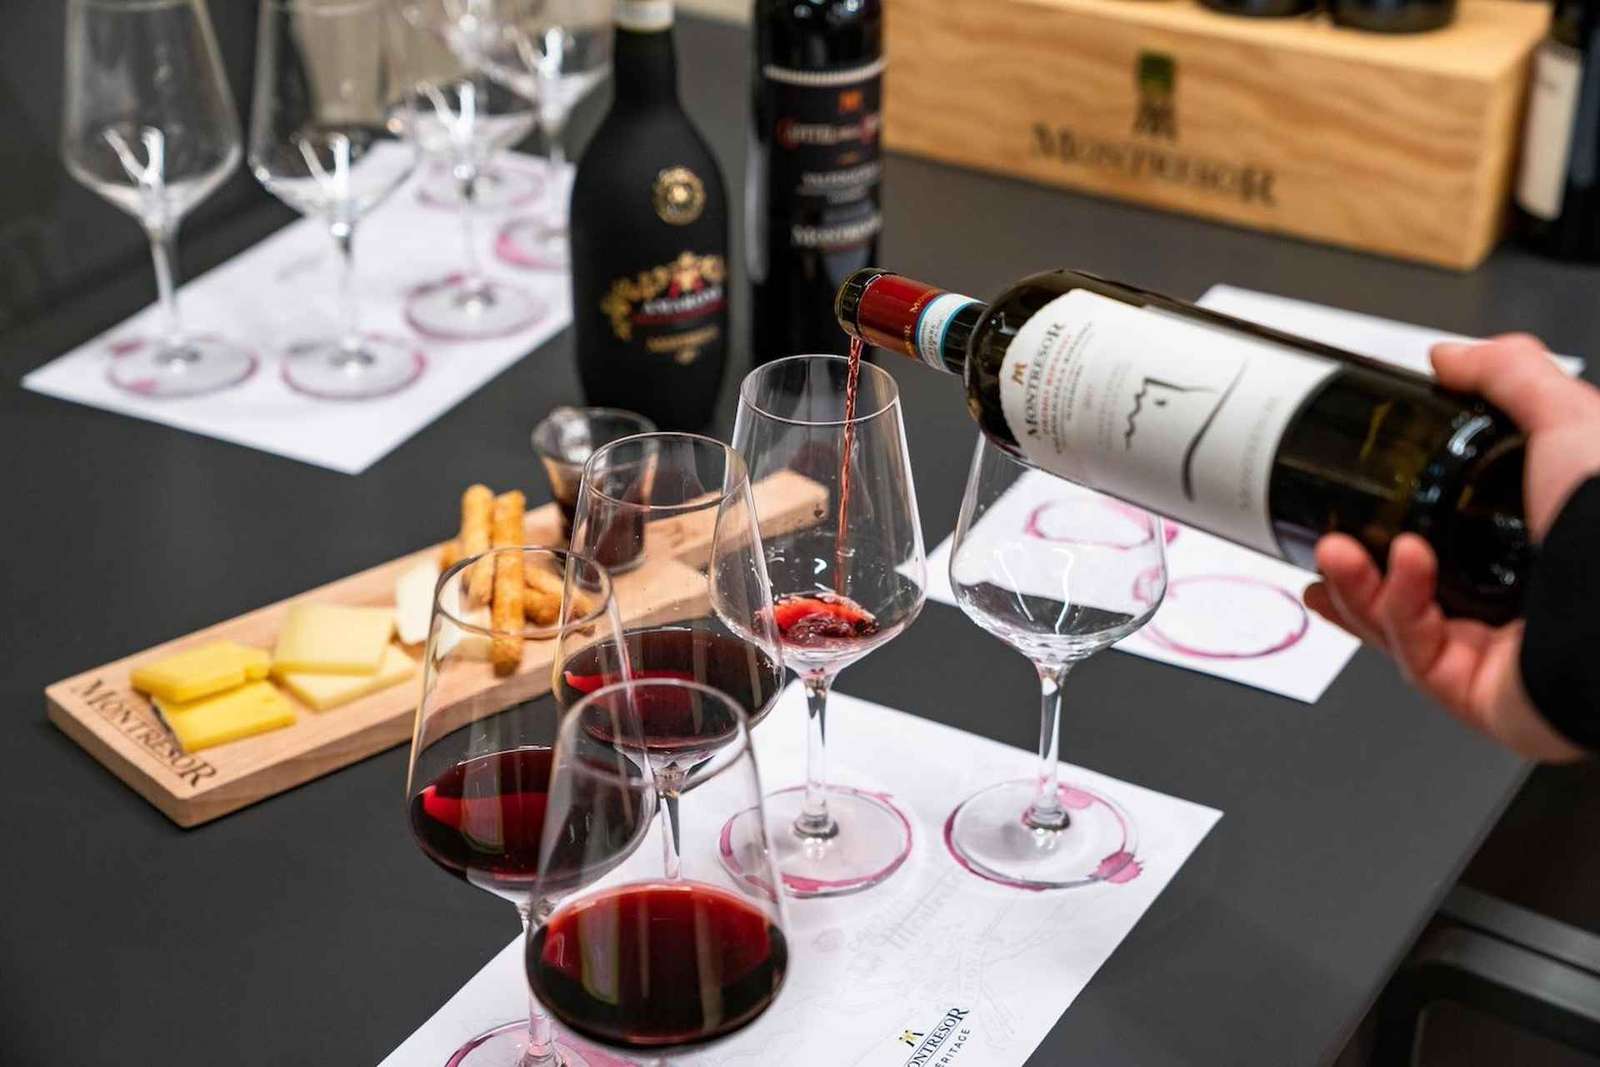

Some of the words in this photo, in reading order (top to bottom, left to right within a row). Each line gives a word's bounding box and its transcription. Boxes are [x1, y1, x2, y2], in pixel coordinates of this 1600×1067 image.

[1024, 322, 1065, 440] MONTRESOR
[69, 679, 218, 788] MONTRESOR
[906, 1007, 969, 1067] ONTRESOR
[934, 1027, 971, 1067] ERITAGE
